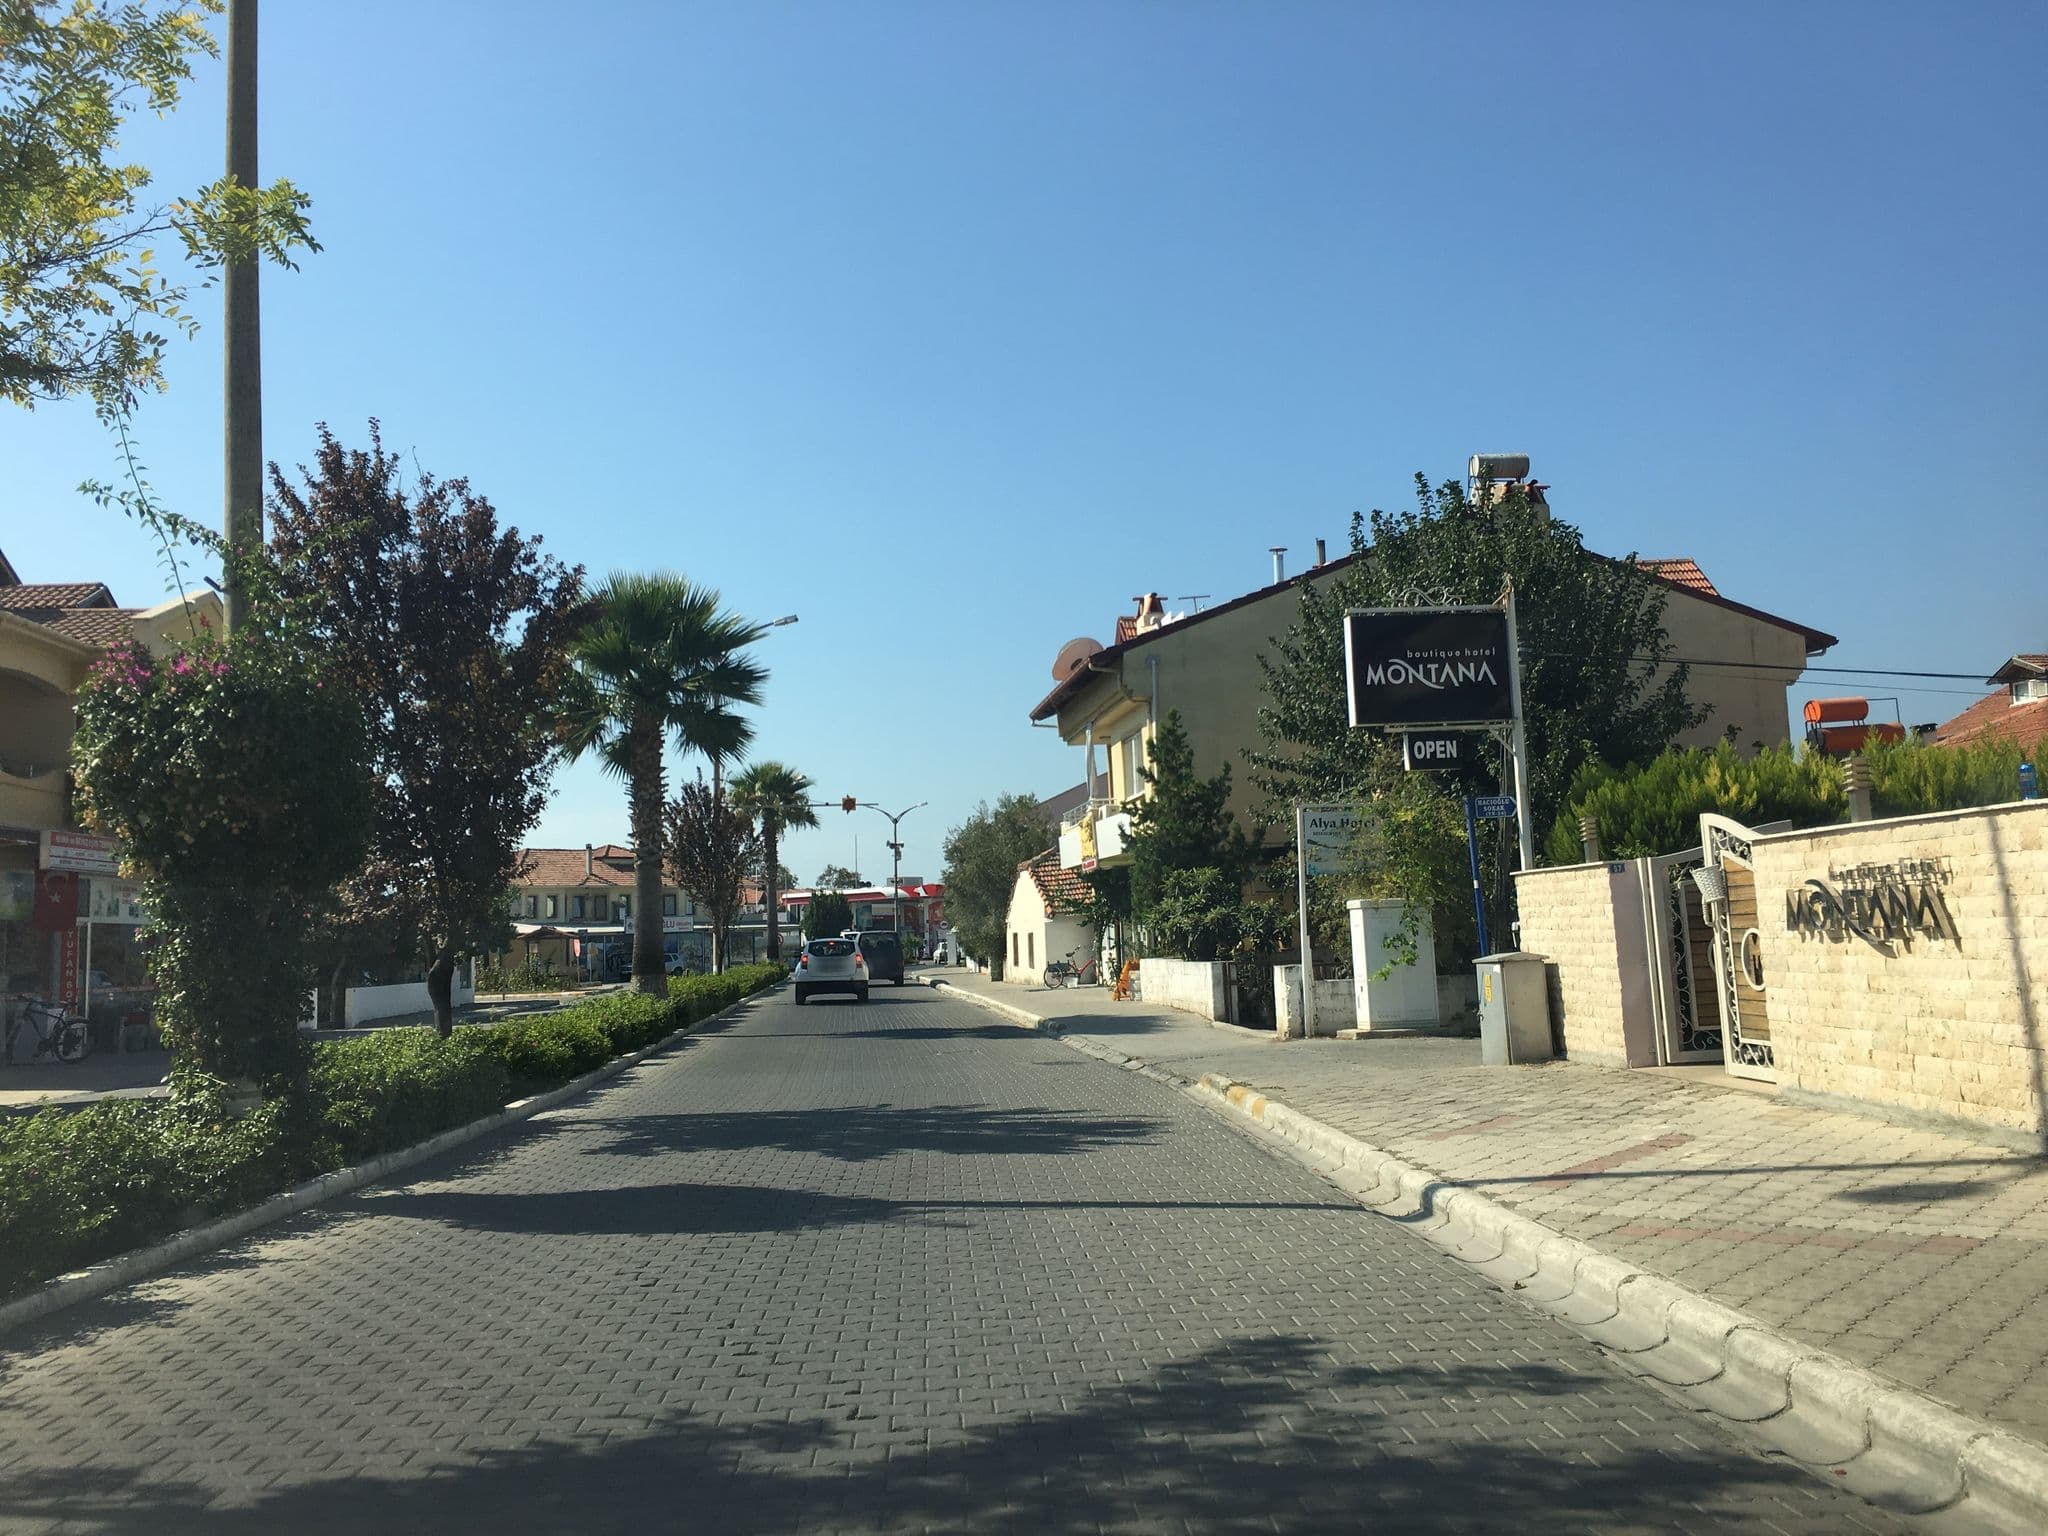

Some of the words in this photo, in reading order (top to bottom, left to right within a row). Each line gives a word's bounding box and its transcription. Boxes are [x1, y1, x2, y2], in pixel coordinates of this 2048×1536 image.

[1406, 649, 1461, 659] boutique
[1464, 647, 1496, 657] hotel
[1366, 658, 1498, 690] MONTANA
[1413, 740, 1458, 760] OPEN
[1309, 817, 1337, 832] Alya
